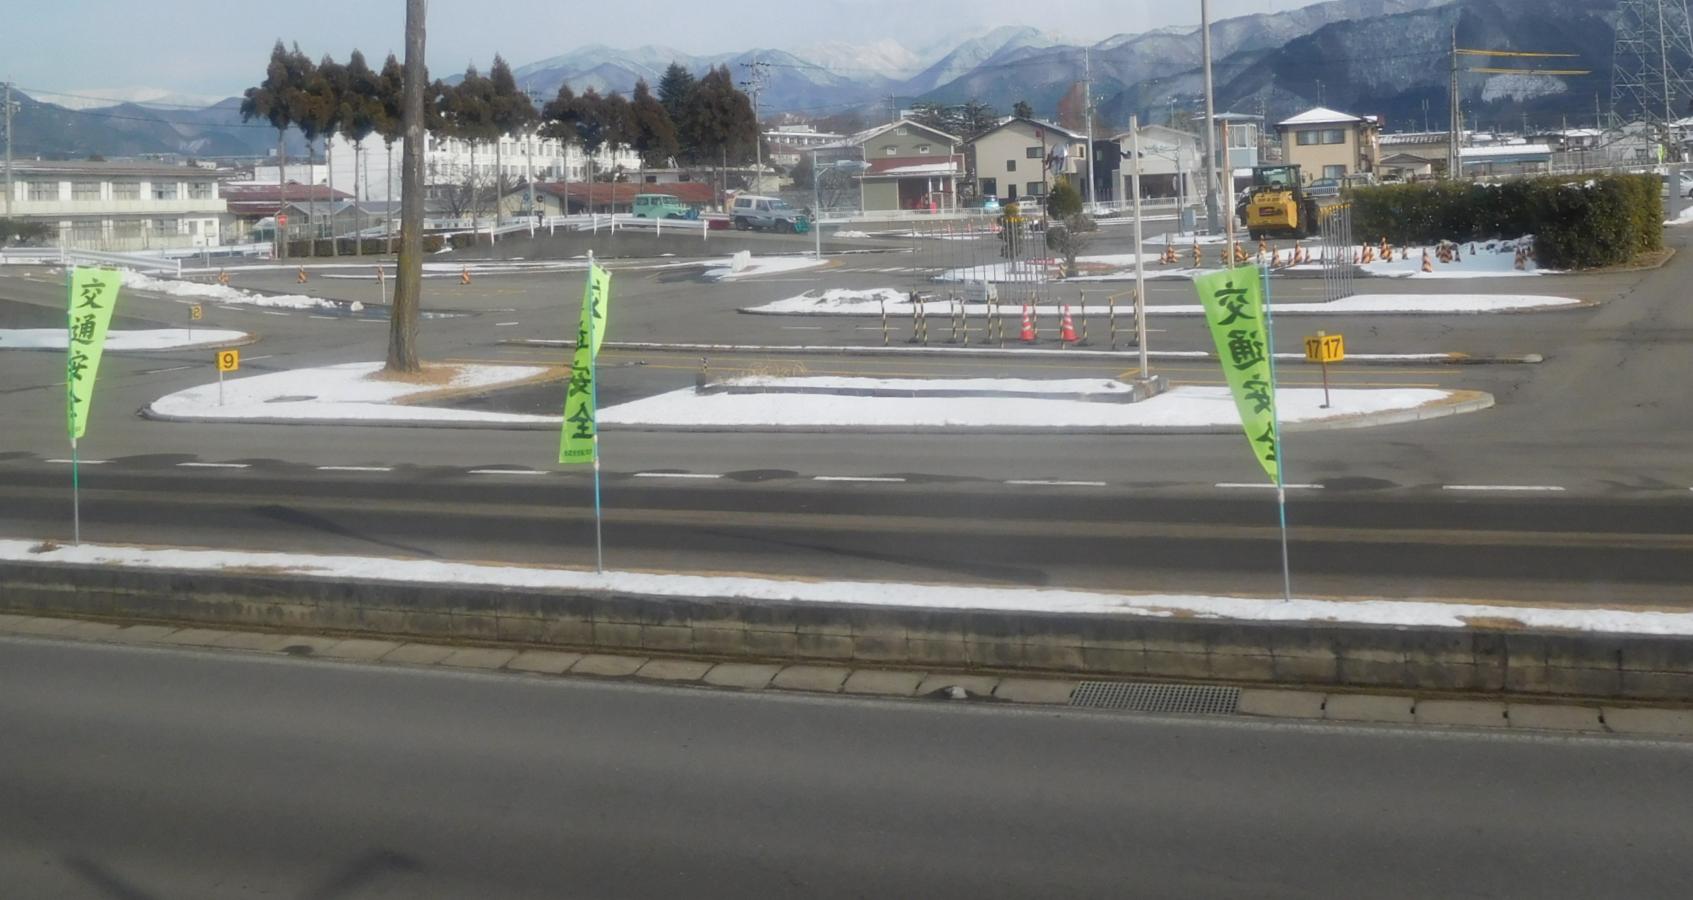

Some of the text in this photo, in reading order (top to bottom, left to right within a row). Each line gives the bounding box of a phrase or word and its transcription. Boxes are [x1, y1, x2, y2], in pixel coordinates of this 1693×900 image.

[1306, 339, 1321, 358] 17
[1324, 338, 1340, 359] 17
[223, 352, 234, 369] 9
